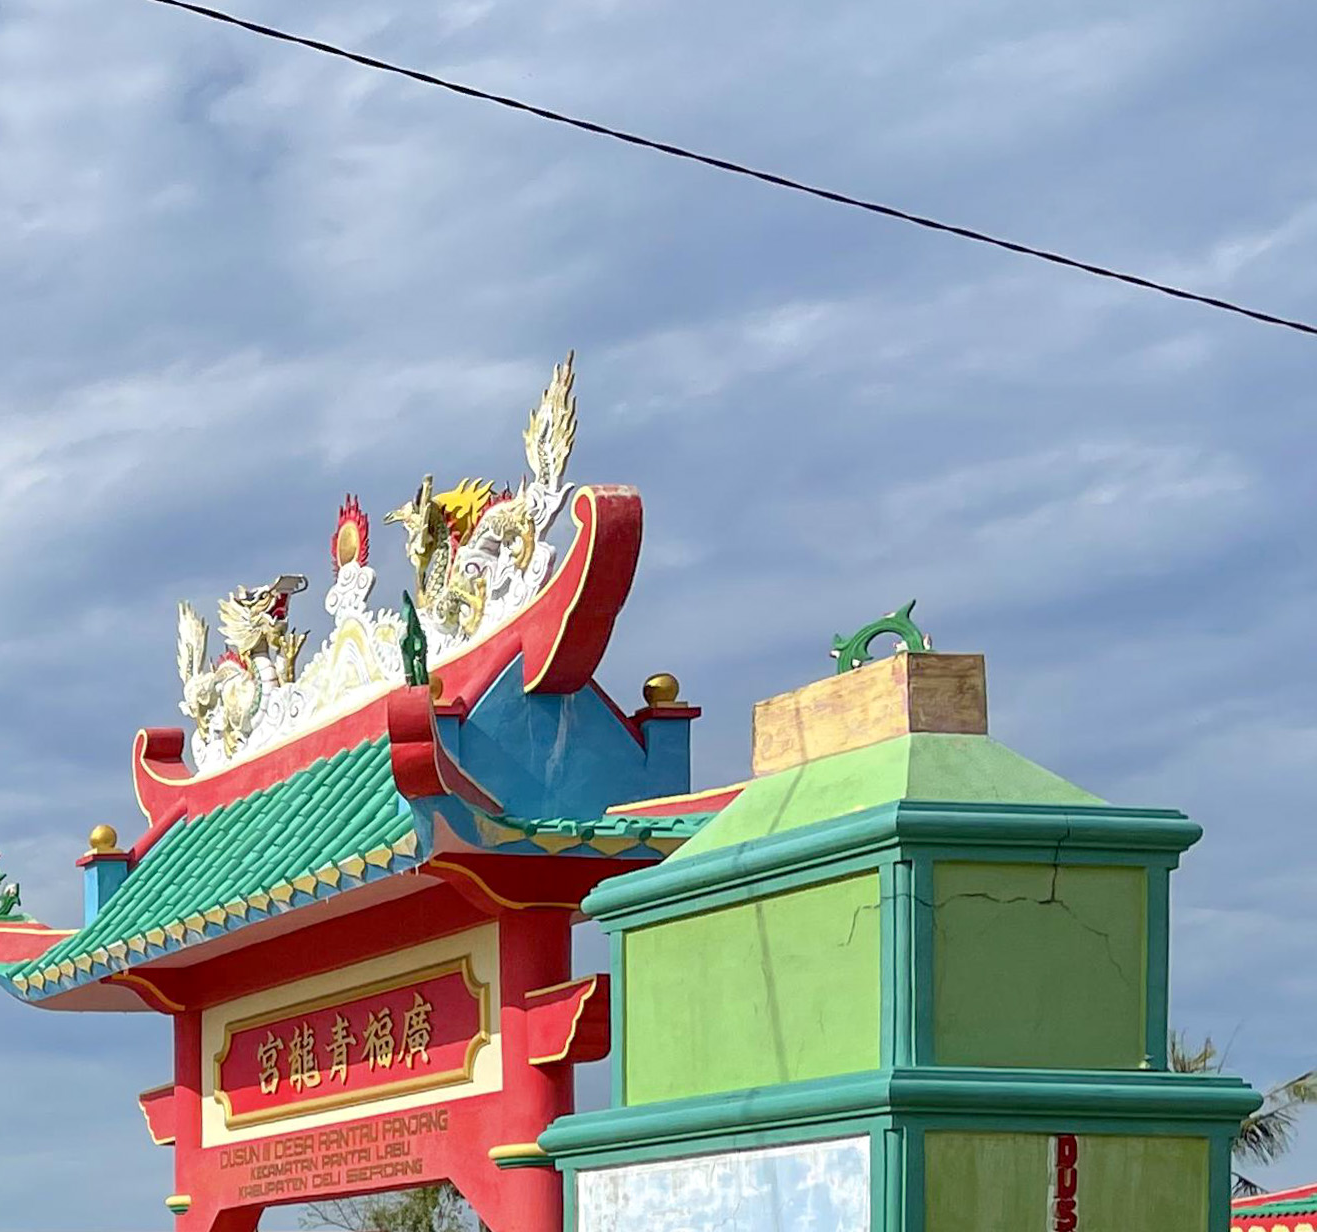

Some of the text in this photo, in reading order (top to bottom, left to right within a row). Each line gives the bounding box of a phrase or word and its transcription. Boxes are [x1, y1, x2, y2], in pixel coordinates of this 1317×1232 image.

[220, 1145, 260, 1169] DUSUN
[274, 1134, 315, 1160] DESA
[318, 1122, 379, 1151] RANTAU
[382, 1109, 449, 1140] PANJANG
[238, 1158, 423, 1200] KABUPATEN DELI SERDANG
[250, 1140, 411, 1181] KECAMATAN PANTAI LABU
